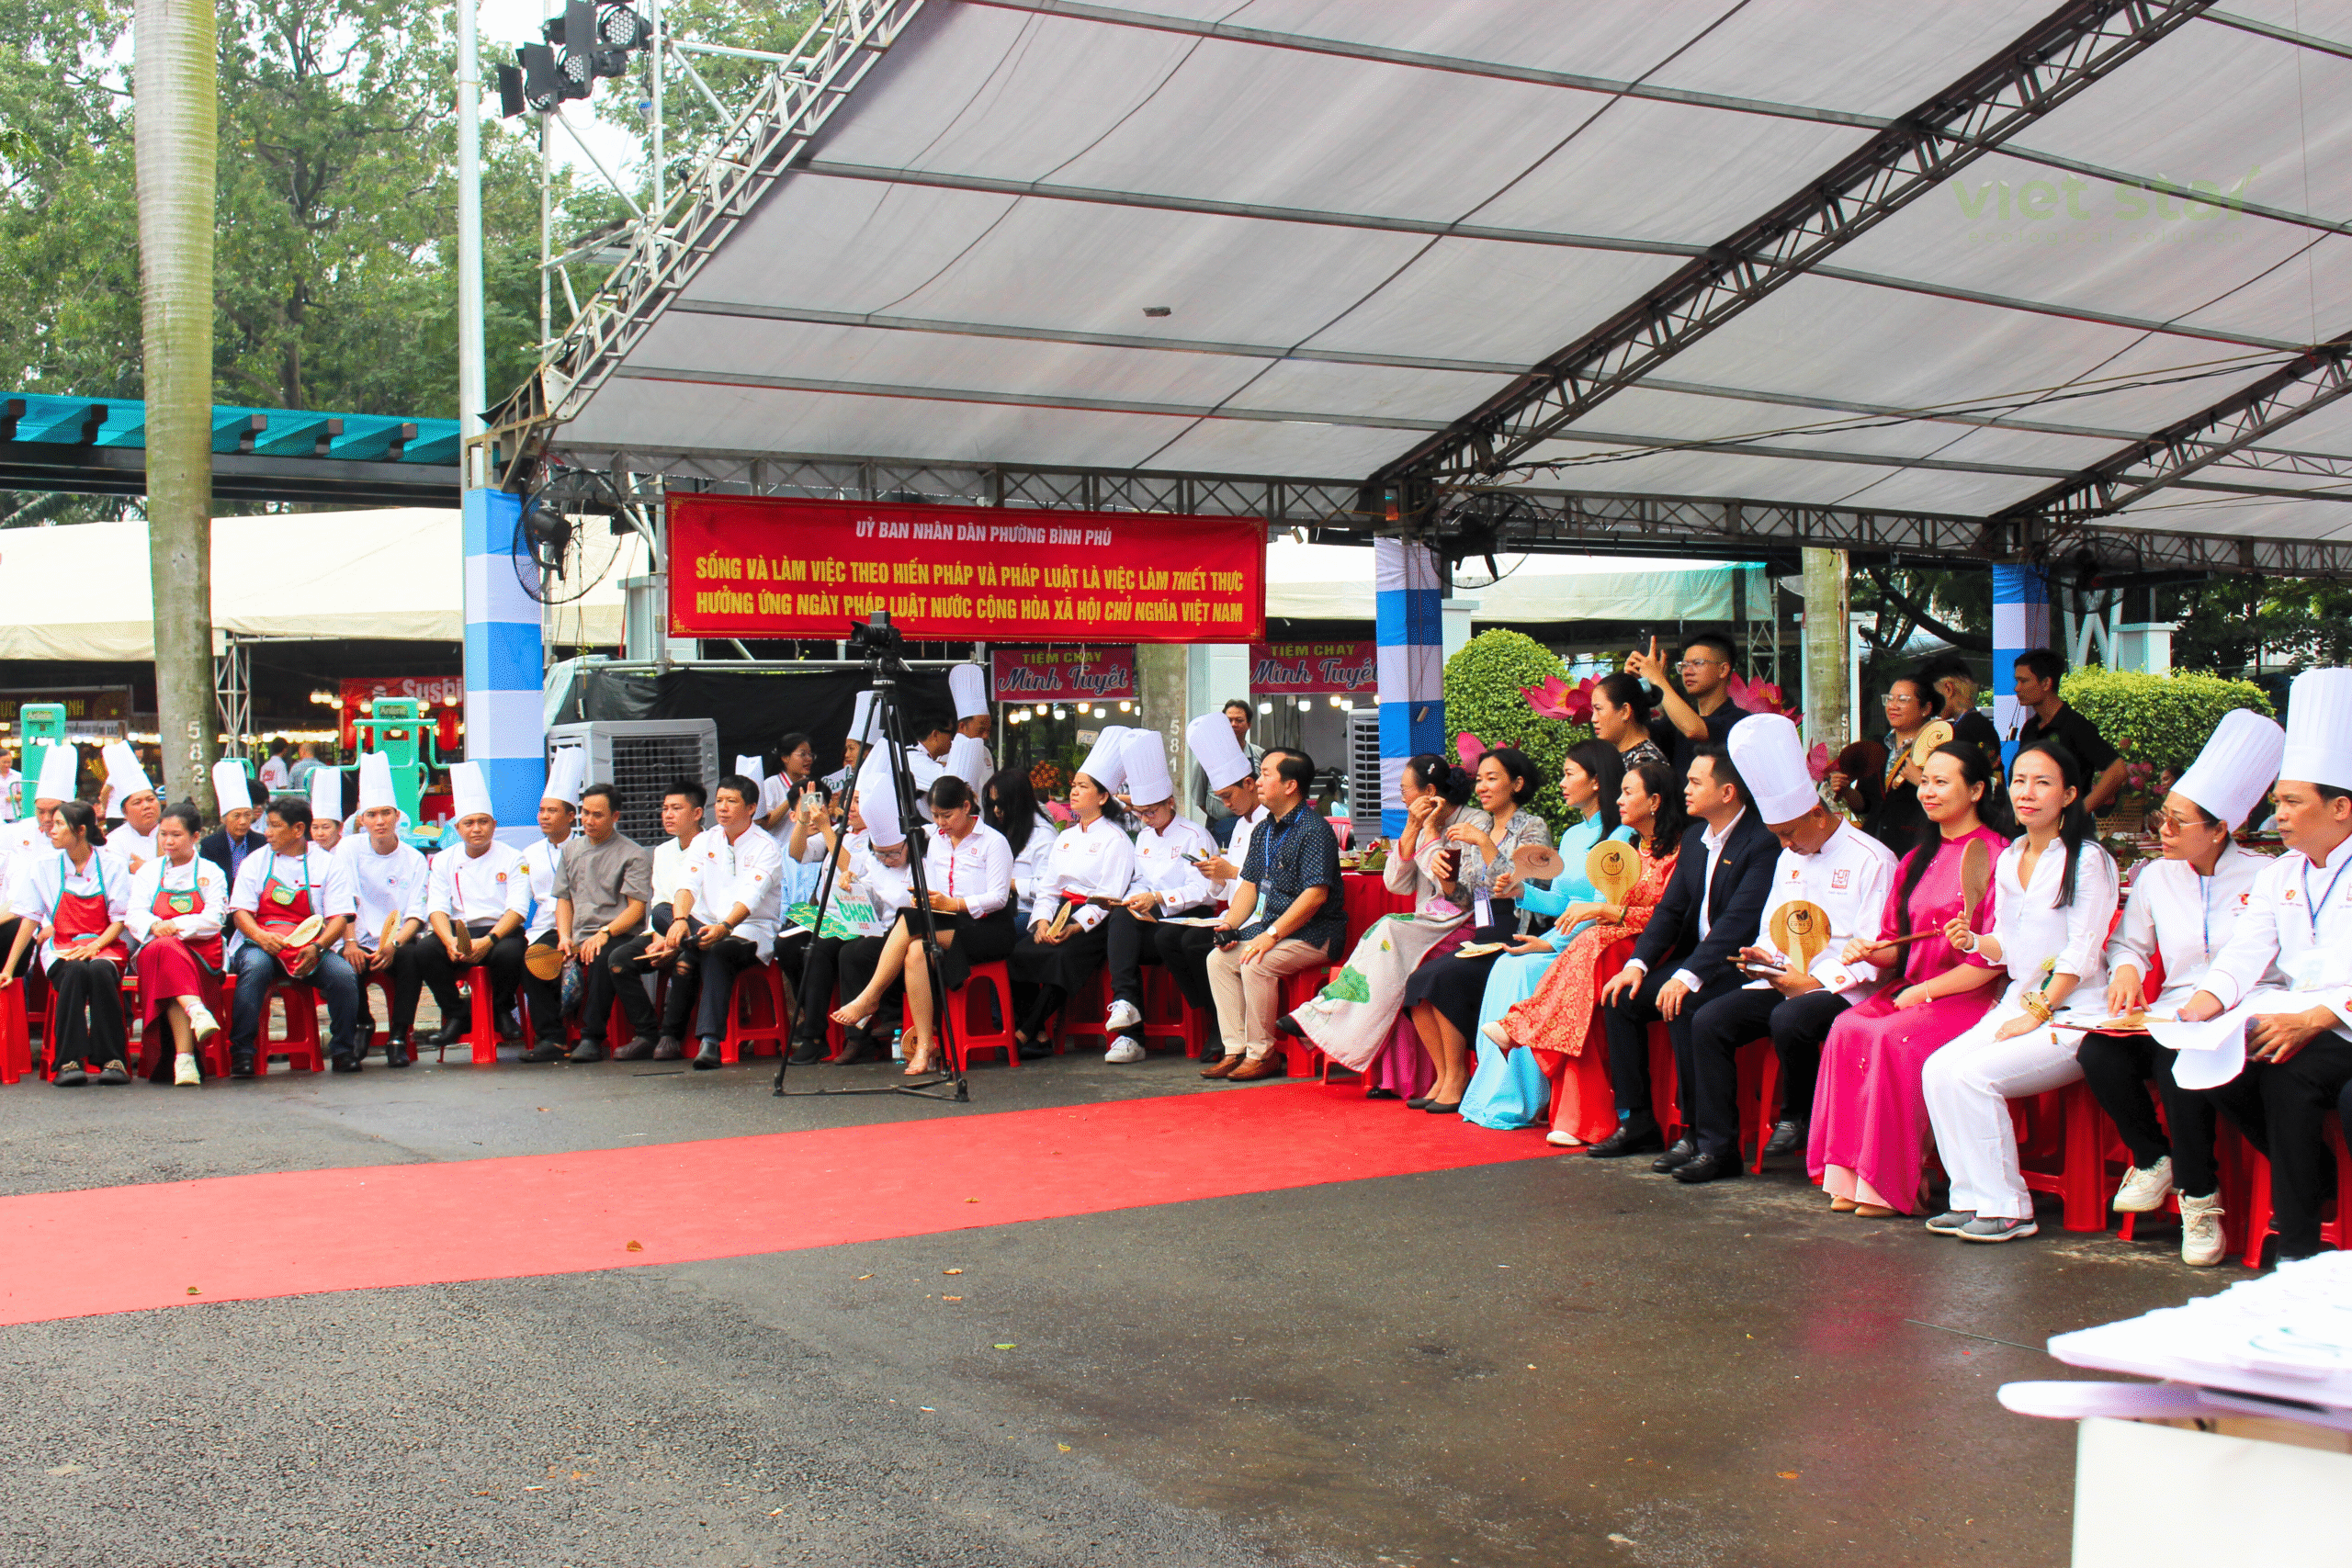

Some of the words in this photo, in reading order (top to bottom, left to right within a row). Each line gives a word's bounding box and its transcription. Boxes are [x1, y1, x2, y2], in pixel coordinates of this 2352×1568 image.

[855, 516, 875, 537] UỶ
[879, 522, 909, 539] BAN
[913, 521, 953, 540] NHÂN
[956, 522, 986, 542] DÂN
[989, 524, 1046, 544] PHƯỜNG
[1049, 525, 1081, 545] BÌNH
[1085, 526, 1112, 547] PHÚ
[695, 550, 741, 580] SỐNG
[746, 554, 768, 581] VÀ
[772, 555, 807, 581] LÀM
[810, 556, 846, 587] VIỆC
[850, 561, 889, 583] THEO
[893, 557, 931, 585] HIẾN
[933, 560, 973, 586] PHÁP
[977, 561, 997, 586] VÀ
[1001, 563, 1040, 587] PHÁP
[1044, 564, 1079, 592] LUẬT
[1082, 565, 1101, 589] LÀ
[1103, 566, 1135, 594] VIỆC
[1139, 567, 1169, 591] LÀM
[1172, 566, 1207, 592] THIẾT
[1210, 571, 1243, 595] THỰC
[696, 584, 754, 615] HƯỞNG
[758, 589, 792, 615] ỨNG
[797, 590, 839, 615] NGÀY
[843, 591, 886, 616] PHÁP
[889, 592, 927, 622] LUẬT
[931, 593, 971, 618] NƯỚC
[977, 594, 1017, 624] CỘNG
[1021, 594, 1050, 620] HÒA
[1054, 596, 1073, 620] XÃ
[1077, 596, 1101, 626] HỘI
[1104, 595, 1132, 621] CHỦ
[1135, 598, 1178, 622] NGHĨA
[1182, 599, 1210, 626] VIỆT
[1213, 603, 1243, 622] NAM
[1023, 651, 1059, 665] TIỆM
[1064, 652, 1102, 663] CHAY
[1272, 644, 1309, 659] TIỆM
[1314, 645, 1355, 657] CHAY
[998, 667, 1063, 691] Minh
[1068, 663, 1129, 695] Tuyết
[1250, 660, 1312, 683] Minh
[402, 679, 463, 705] Sushi
[187, 720, 207, 783] 582
[1169, 718, 1180, 773] 581
